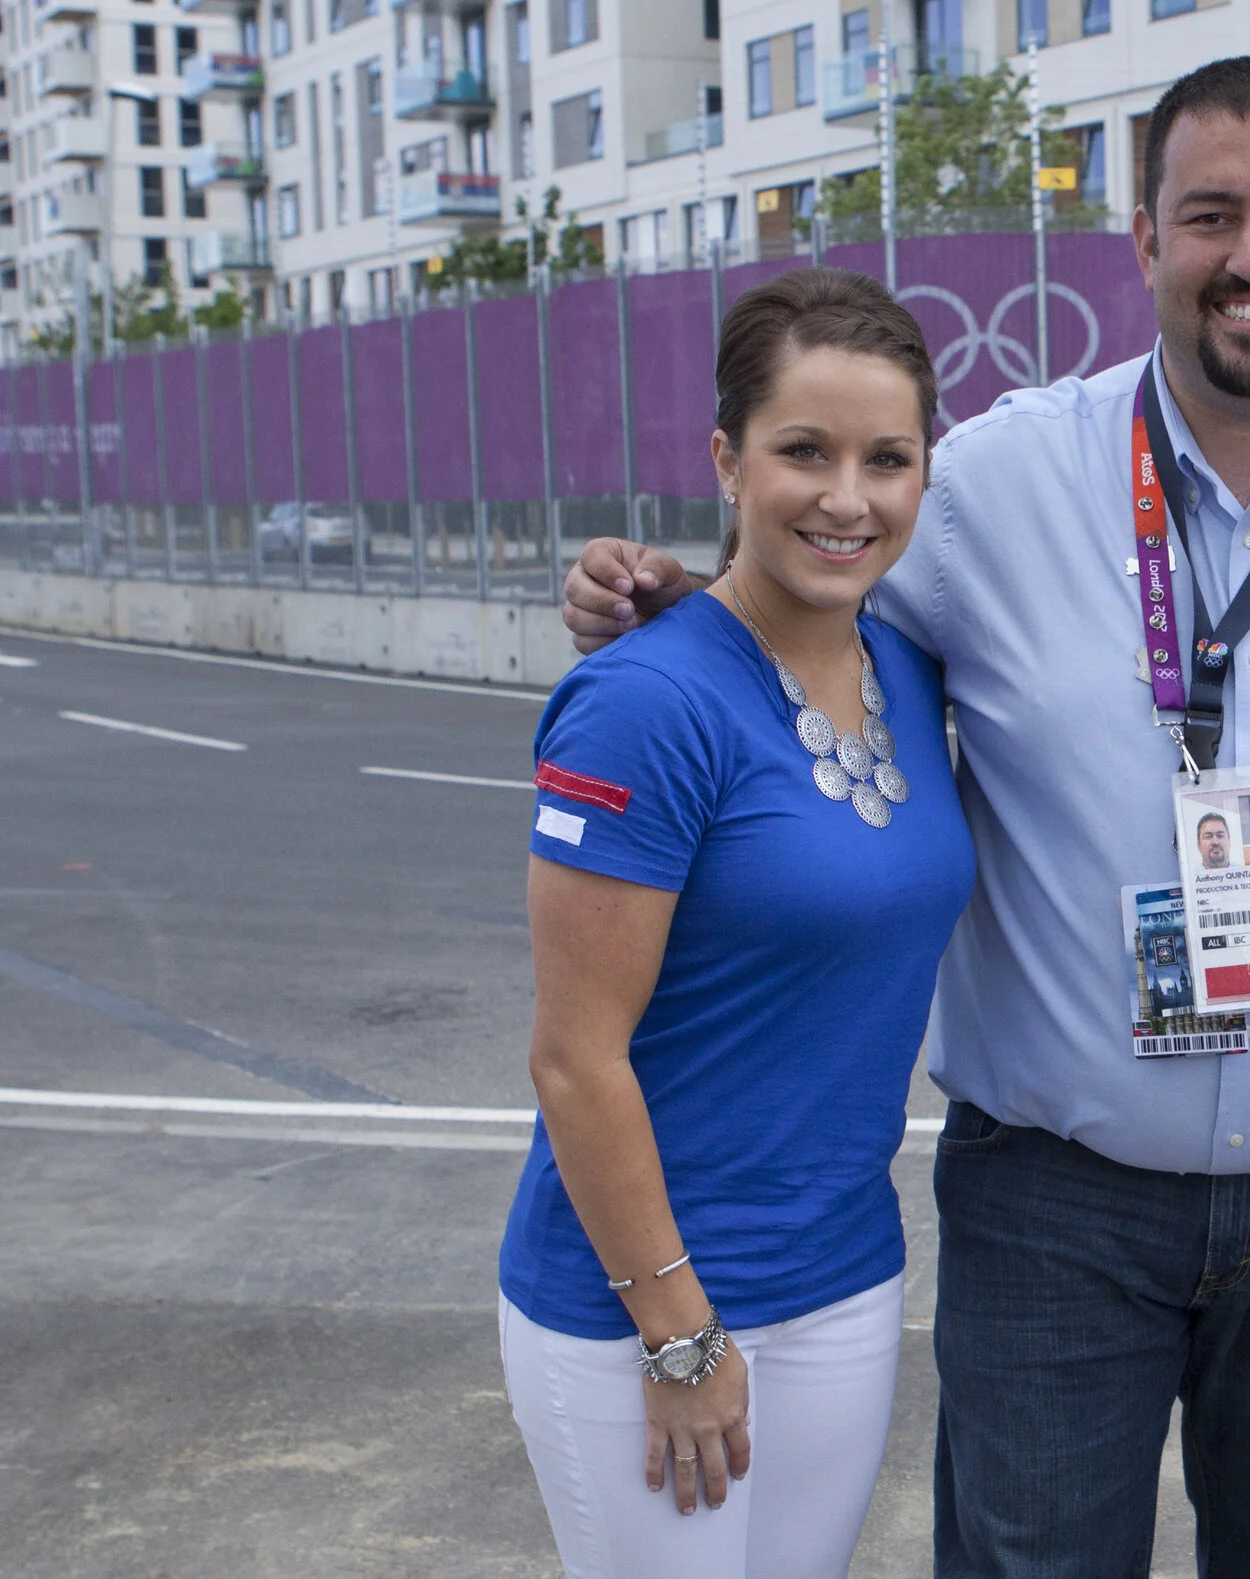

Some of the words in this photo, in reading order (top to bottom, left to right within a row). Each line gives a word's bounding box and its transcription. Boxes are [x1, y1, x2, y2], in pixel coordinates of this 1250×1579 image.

[1149, 559, 1164, 592] Lond
[1195, 873, 1224, 883] Anthony
[1195, 885, 1233, 894] PRODUCTION
[1156, 938, 1171, 946] NBC
[1207, 938, 1221, 948] ALL
[1233, 935, 1247, 945] IBC
